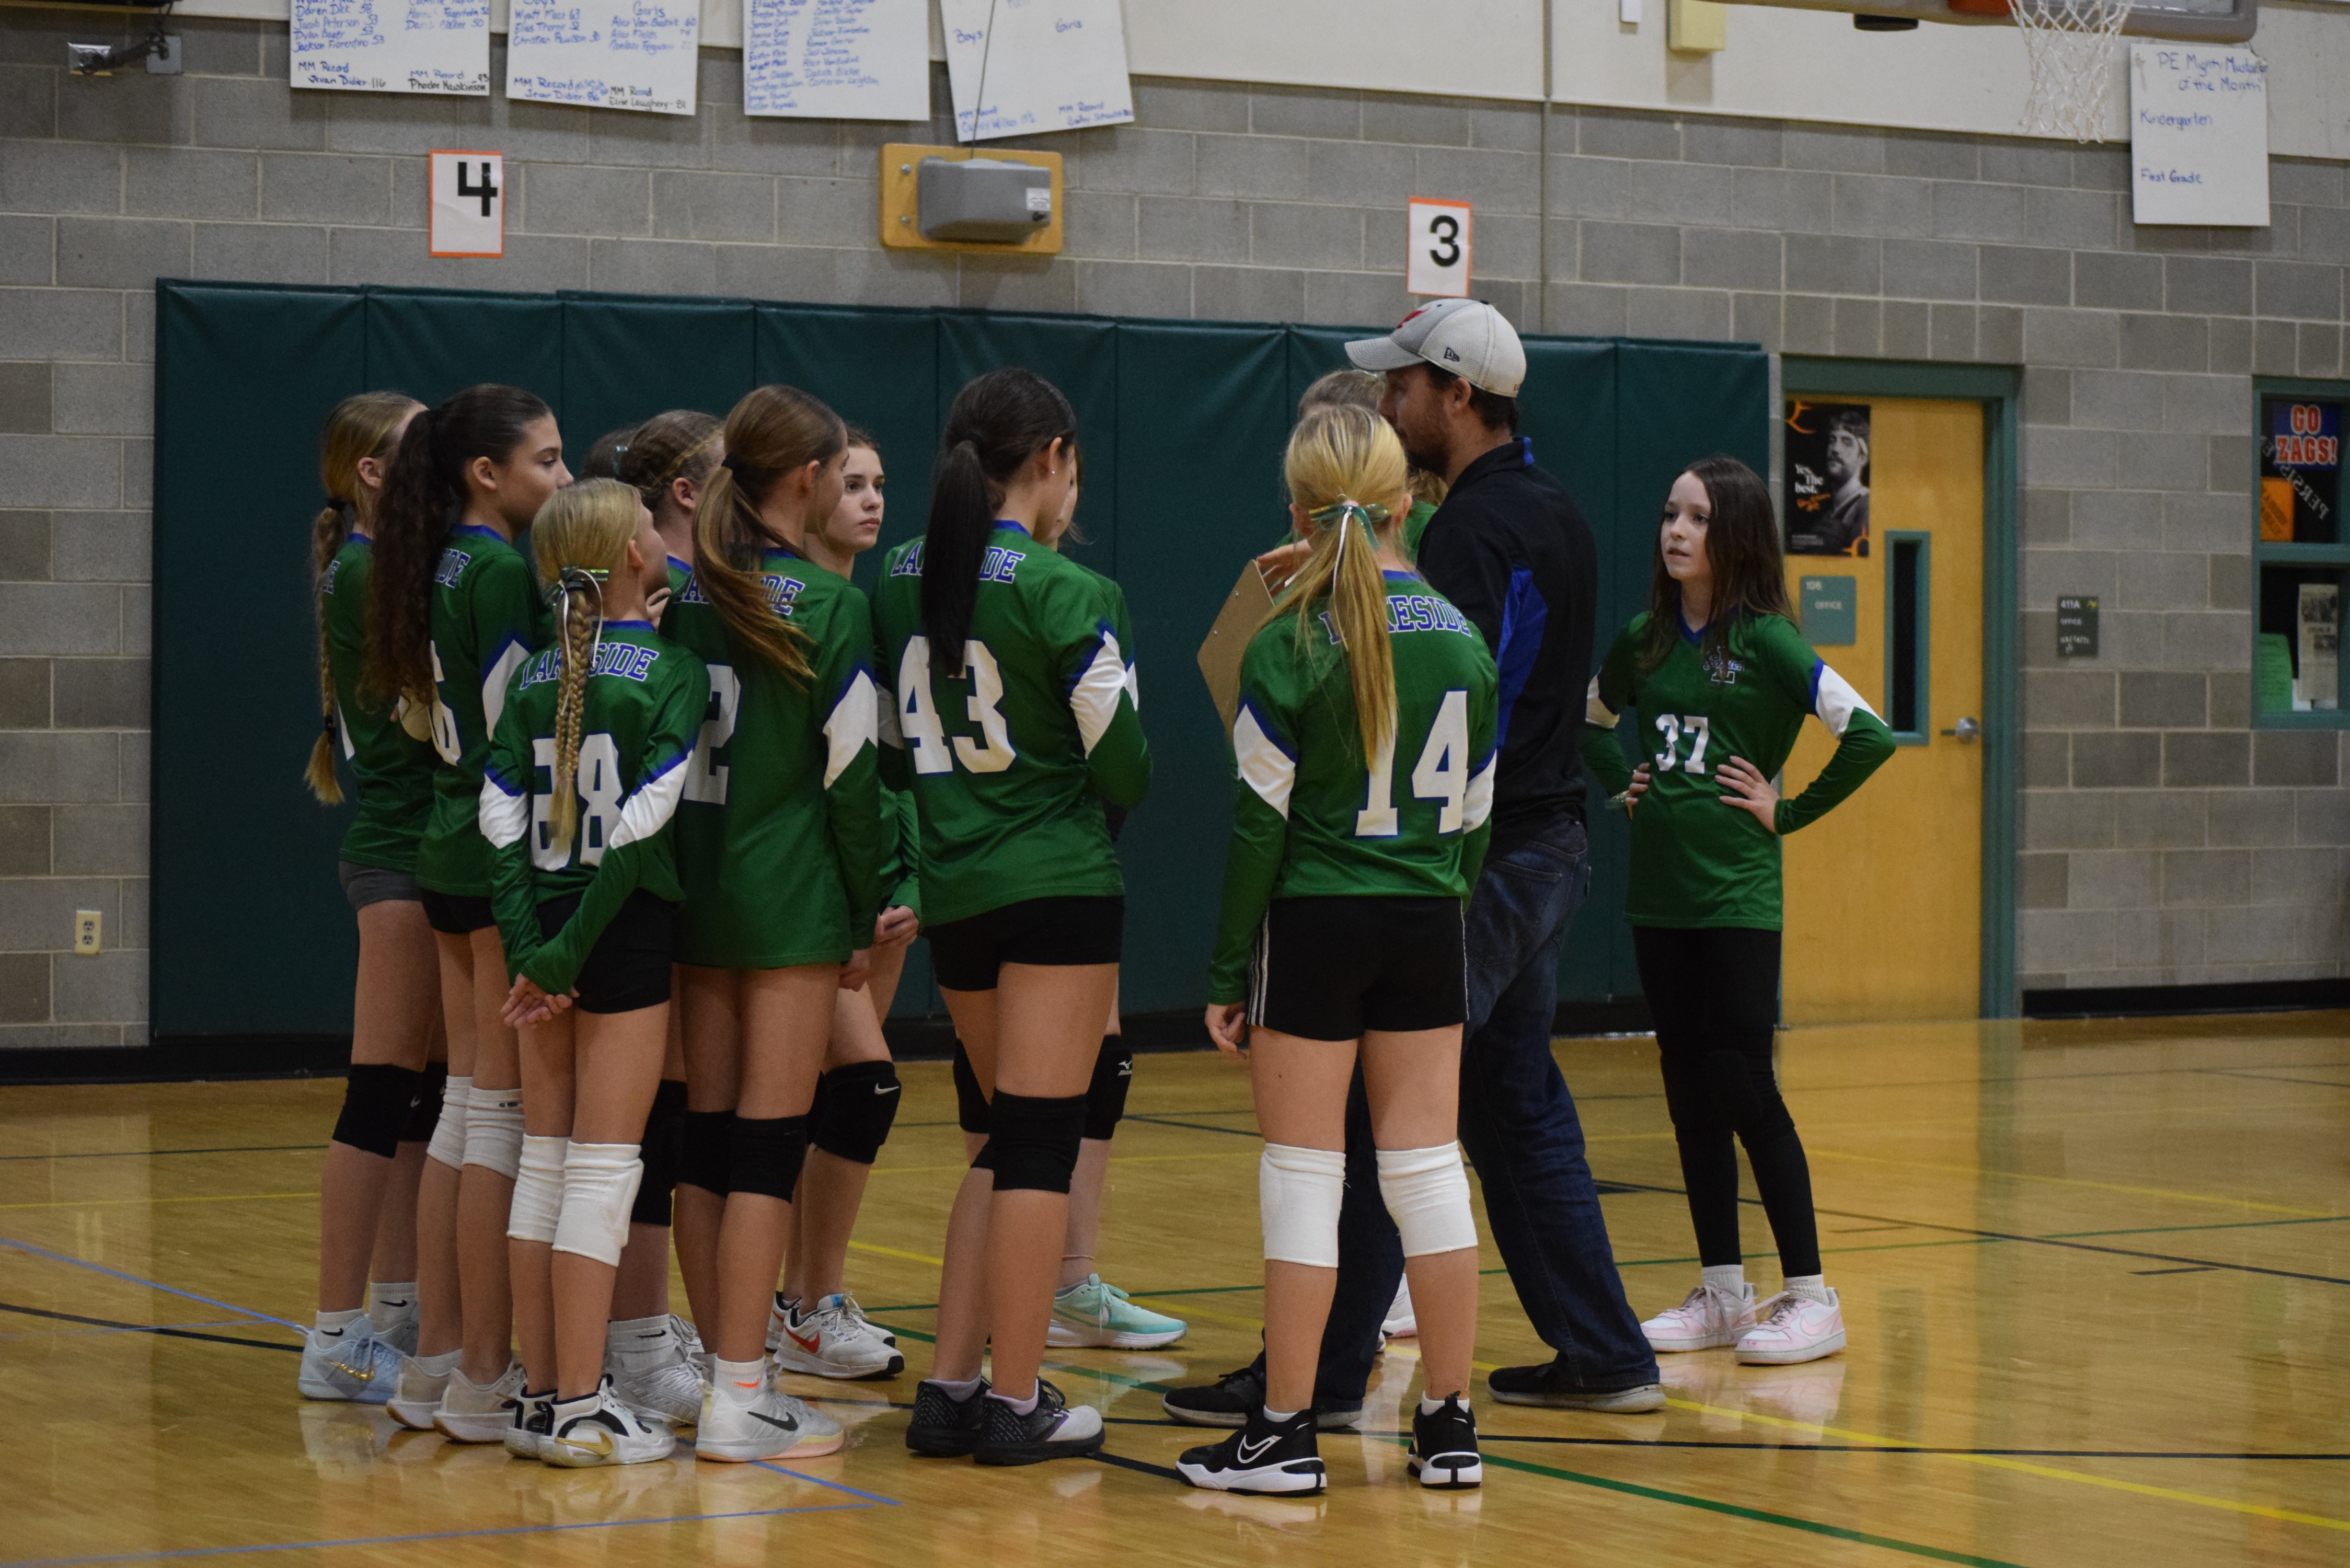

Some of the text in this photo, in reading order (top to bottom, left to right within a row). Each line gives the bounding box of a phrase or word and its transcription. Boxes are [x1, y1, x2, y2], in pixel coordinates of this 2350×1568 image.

[298, 61, 349, 73] MM Record
[537, 76, 573, 90] Record
[457, 162, 498, 217] 4
[1429, 214, 1460, 268] 3
[2290, 405, 2321, 435] GO
[2275, 434, 2339, 466] ZAGS!
[1318, 595, 1472, 645] LESIDE
[1815, 601, 1842, 611] OFFICE
[898, 635, 1017, 774] 43
[1354, 689, 1469, 837] 14
[1655, 713, 1710, 775] 37
